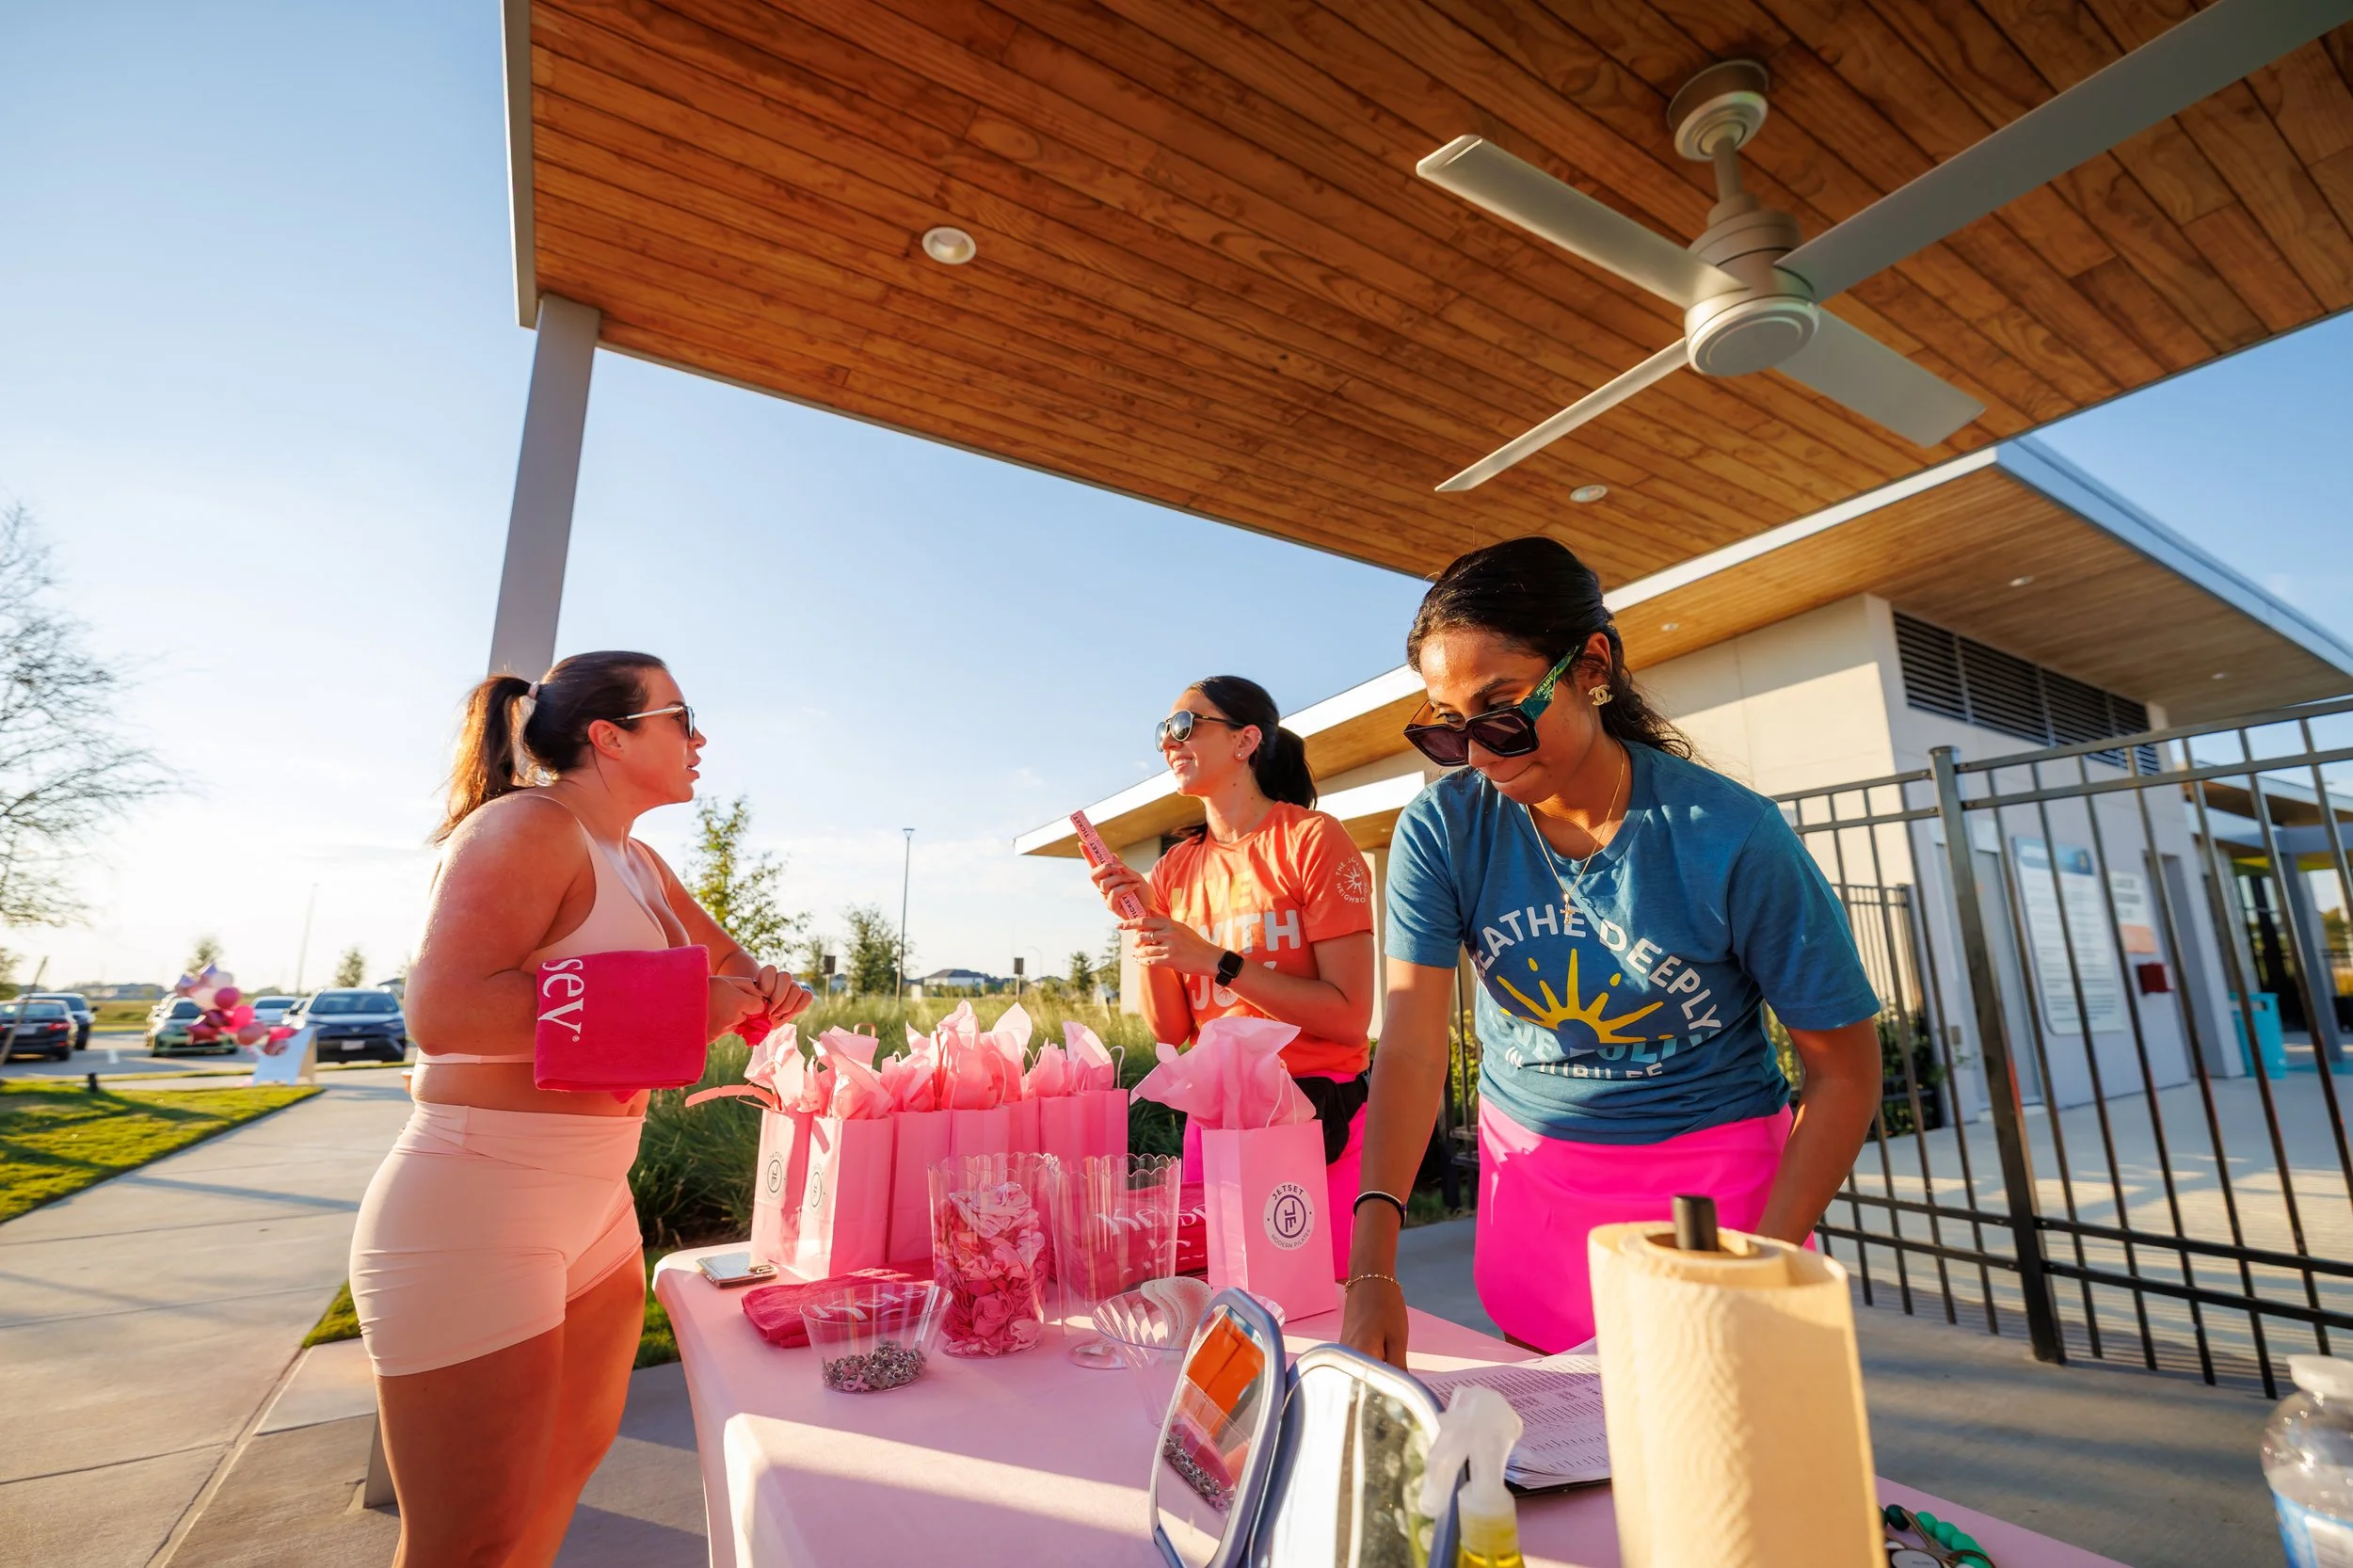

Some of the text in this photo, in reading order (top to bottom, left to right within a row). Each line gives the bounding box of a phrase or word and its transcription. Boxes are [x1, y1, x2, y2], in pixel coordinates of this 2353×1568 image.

[1073, 816, 1089, 838] TICKET
[1090, 842, 1106, 864] TICKET
[1122, 896, 1138, 919] TICKET
[1472, 904, 1722, 1029] EATHE DEEPLY
[1272, 1184, 1304, 1200] JETSET
[1271, 1229, 1311, 1249] MODERN PILATES
